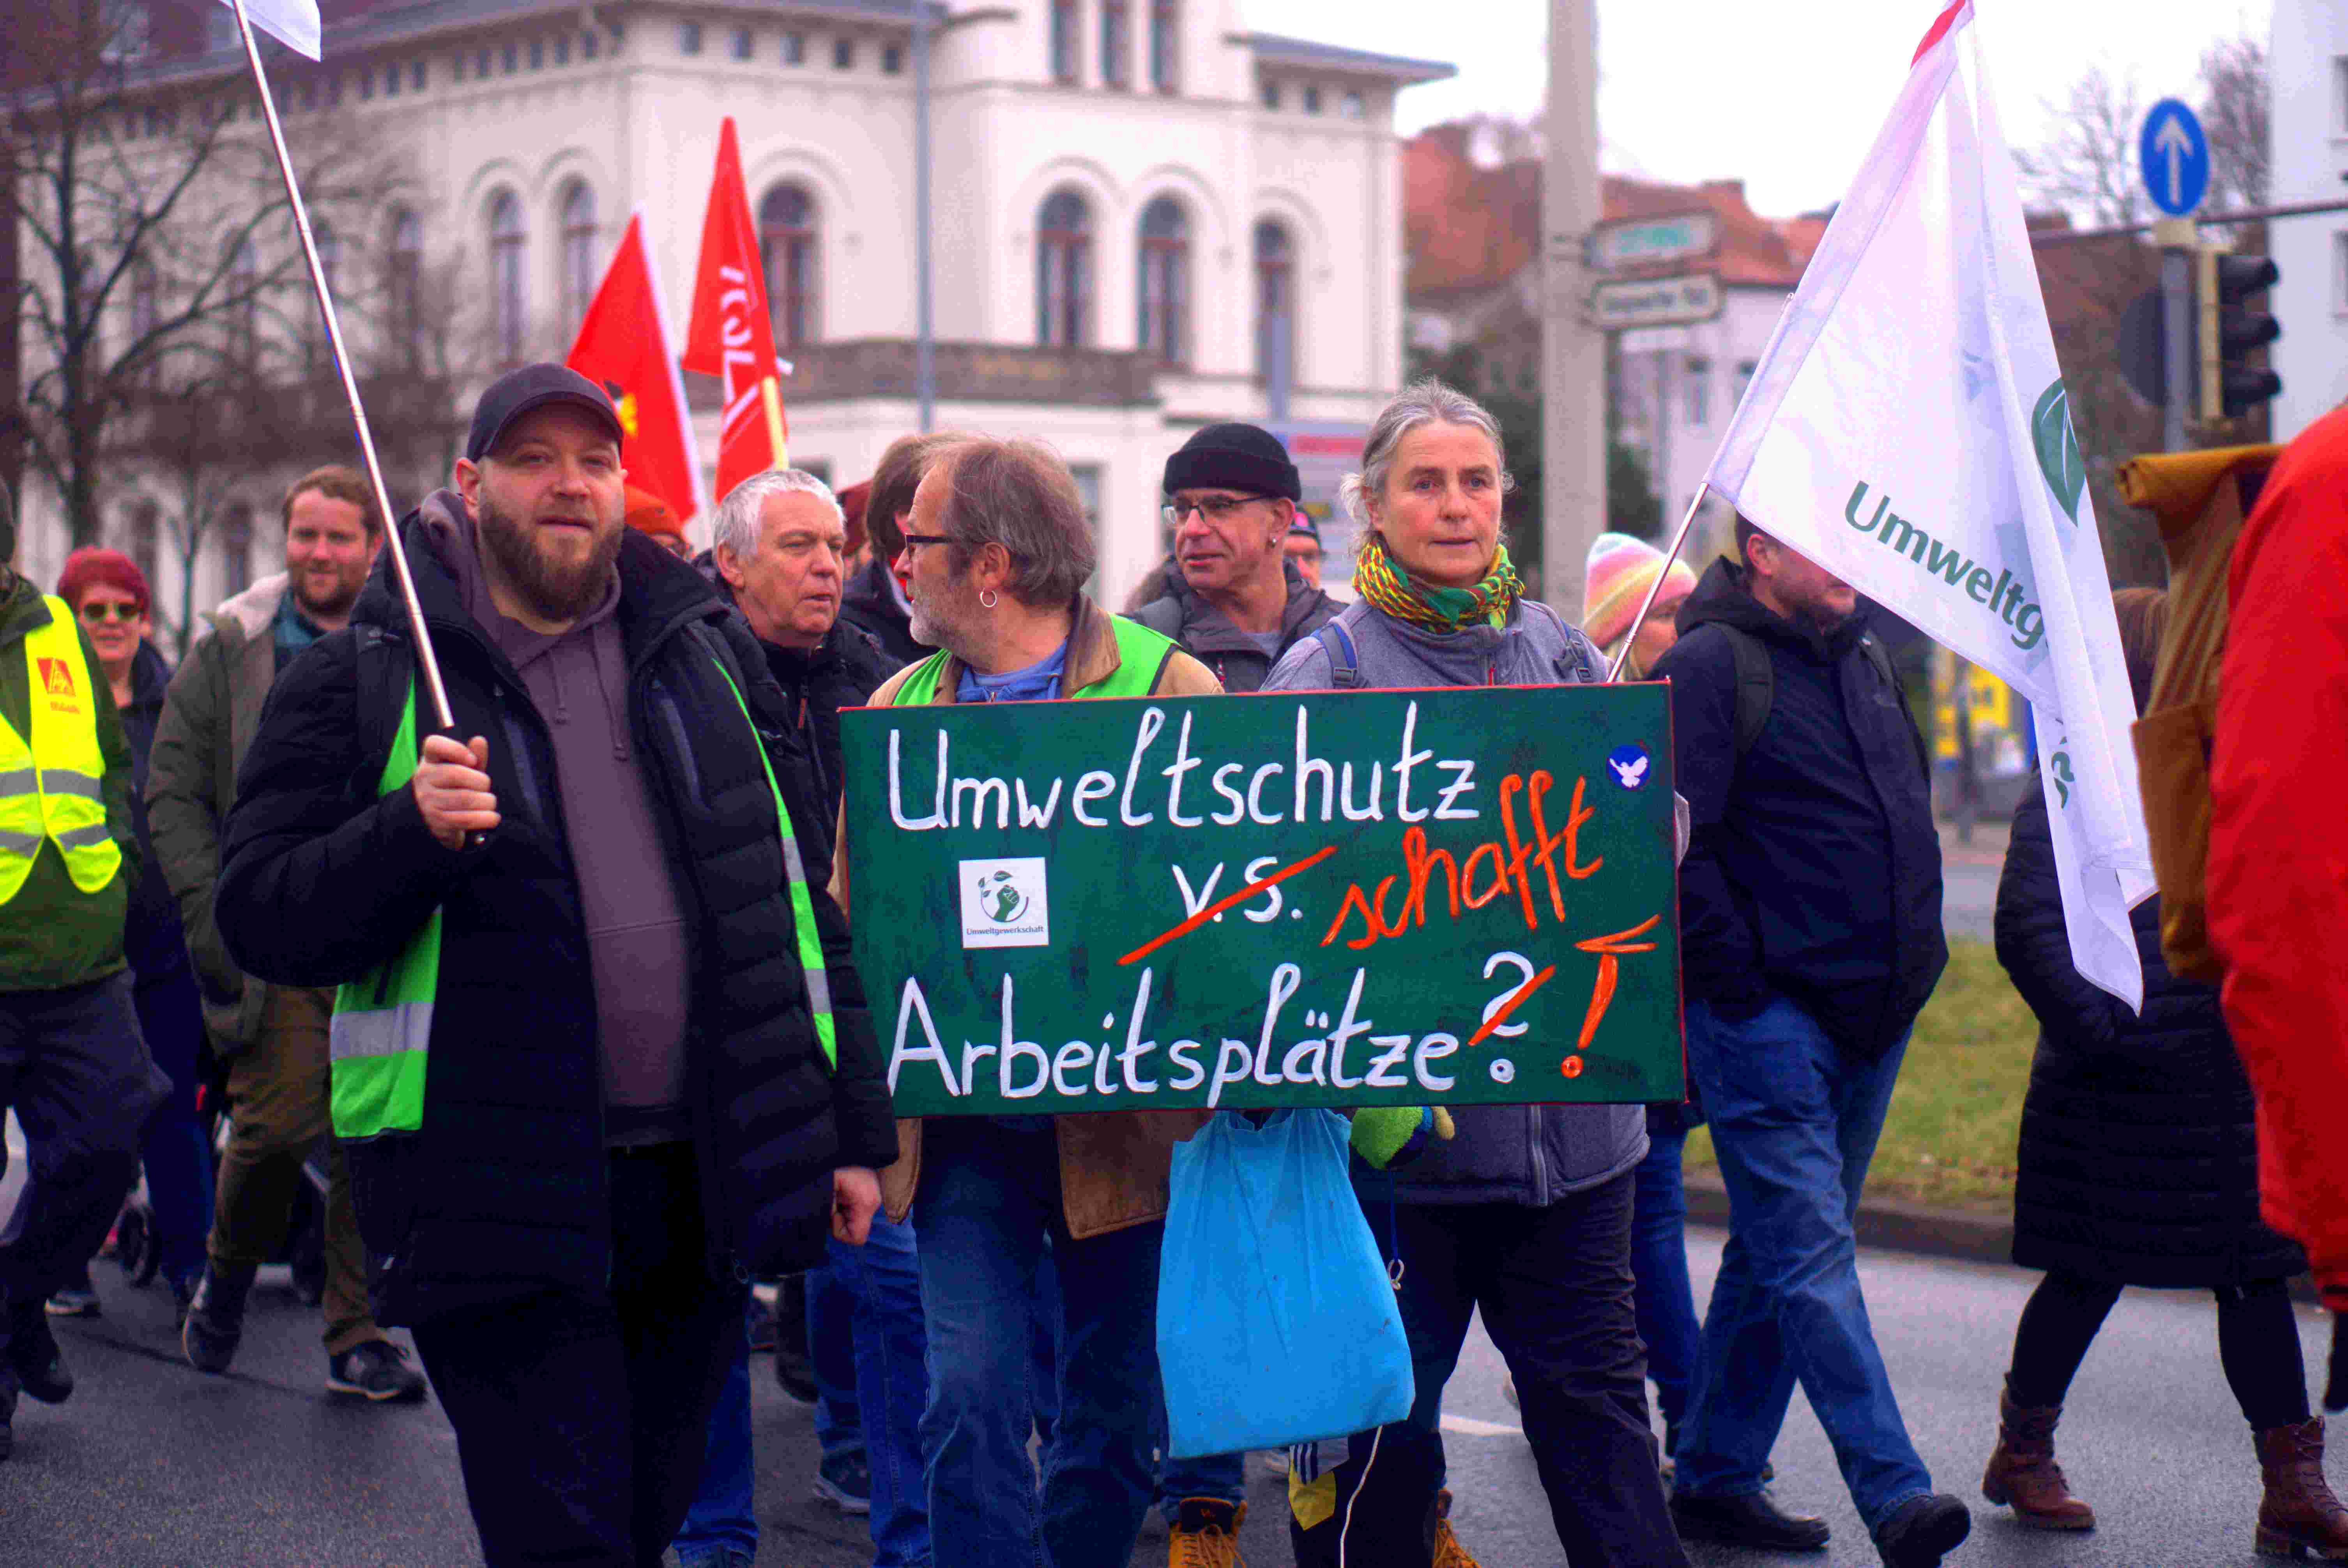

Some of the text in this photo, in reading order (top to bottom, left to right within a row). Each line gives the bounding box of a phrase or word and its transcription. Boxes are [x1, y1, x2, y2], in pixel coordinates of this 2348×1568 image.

[1844, 480, 2048, 650] Umweltg
[889, 700, 1480, 831] Umweltschutz
[966, 926, 1044, 936] Umweltgewerkschaft
[1319, 769, 1604, 950] schafft
